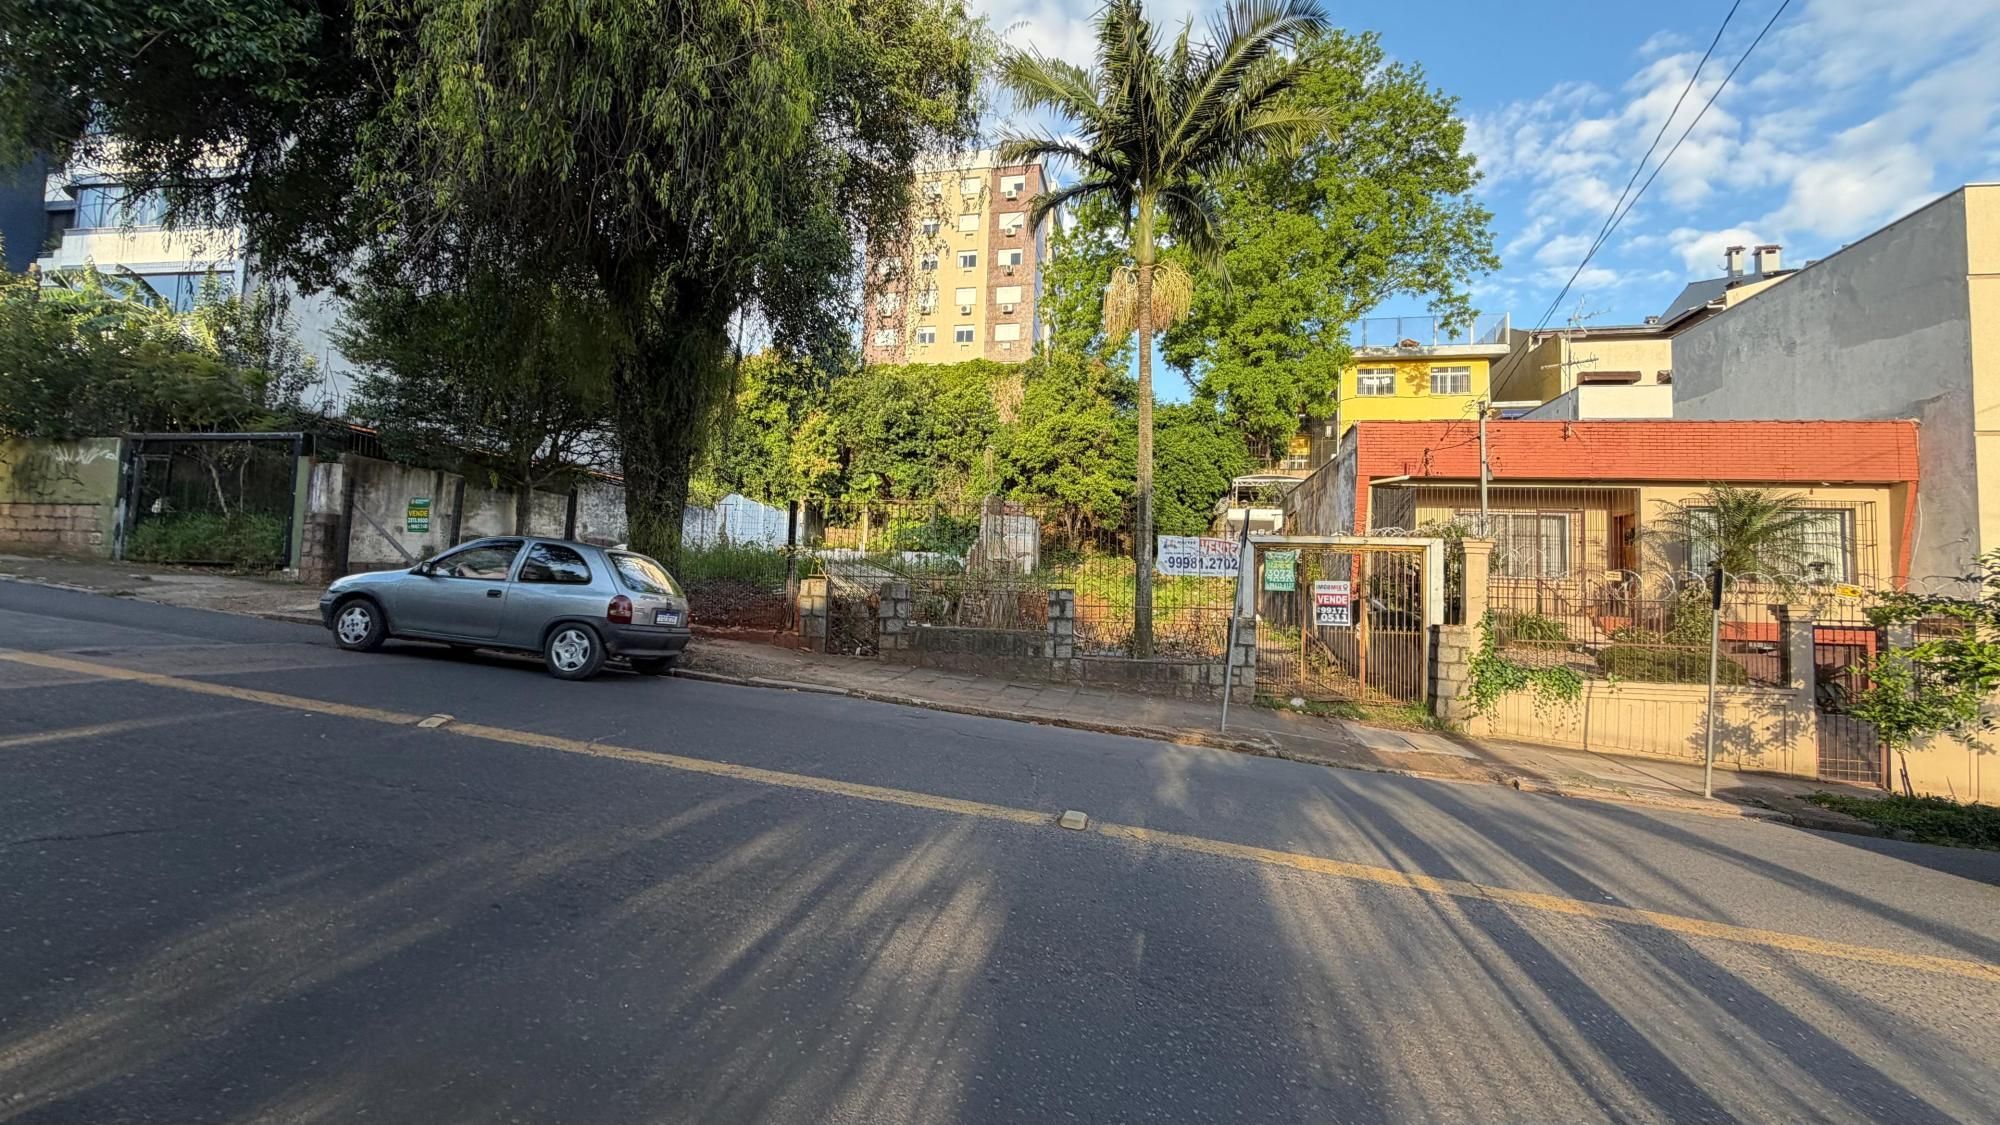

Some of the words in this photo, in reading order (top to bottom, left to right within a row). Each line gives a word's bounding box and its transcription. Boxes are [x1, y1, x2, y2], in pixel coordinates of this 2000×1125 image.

[1201, 539, 1238, 556] VENDE
[1168, 556, 1238, 570] 99981.2702
[1317, 595, 1347, 604] VENDE
[1321, 606, 1347, 614] 99171
[1321, 613, 1347, 622] 0511
